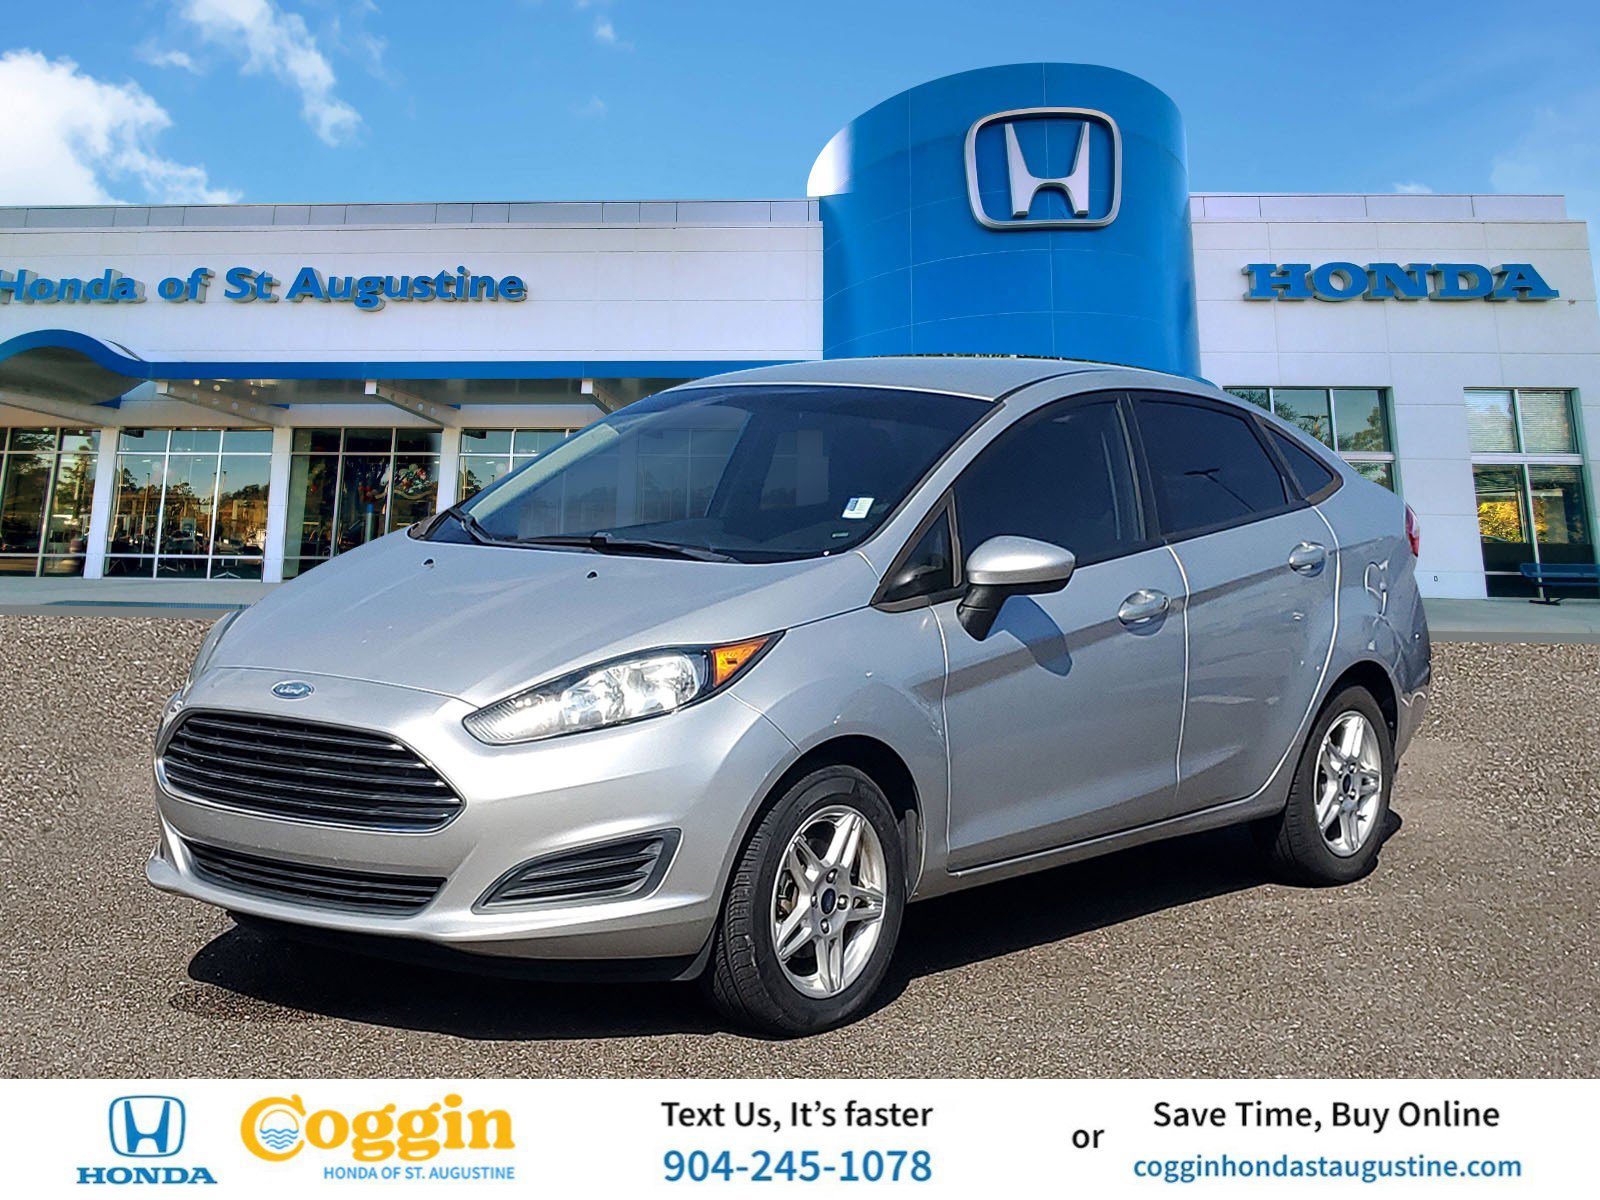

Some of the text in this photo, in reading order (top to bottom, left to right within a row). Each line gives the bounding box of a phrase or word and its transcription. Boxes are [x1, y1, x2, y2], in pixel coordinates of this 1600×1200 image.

[0, 265, 528, 312] Honda of St Augustine
[1241, 261, 1560, 302] HONDA
